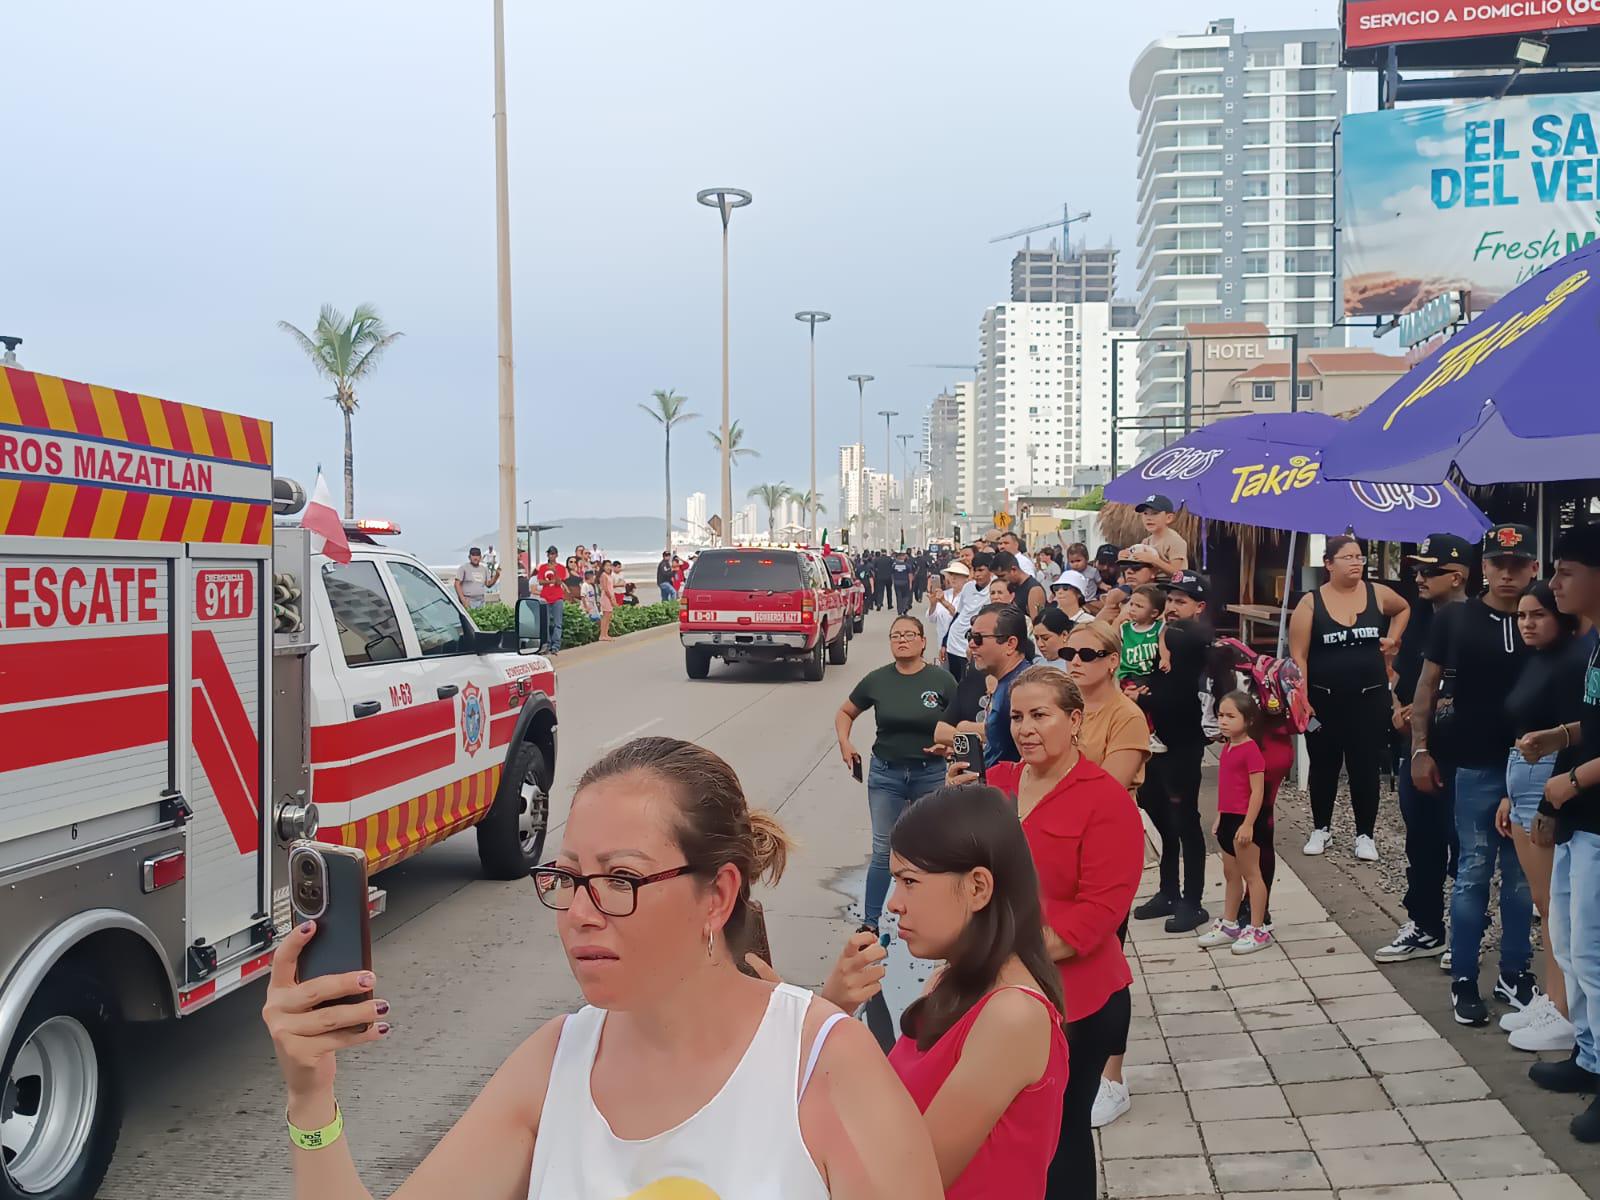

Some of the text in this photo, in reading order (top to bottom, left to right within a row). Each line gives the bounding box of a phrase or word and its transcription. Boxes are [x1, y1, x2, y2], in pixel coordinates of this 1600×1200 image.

[1359, 9, 1440, 30] SERVICIO
[1443, 9, 1458, 23] A
[1463, 1, 1562, 21] DOMICILIO
[1464, 118, 1520, 163] EL
[1431, 158, 1600, 210] DEL VE
[1207, 343, 1265, 360] HOTEL
[74, 445, 214, 493] MAZATLÁN
[1230, 455, 1320, 504] Takis
[0, 566, 158, 629] ESCATE
[205, 582, 244, 617] 911
[1323, 627, 1379, 644] NEW YORK
[71, 822, 78, 841] 6
